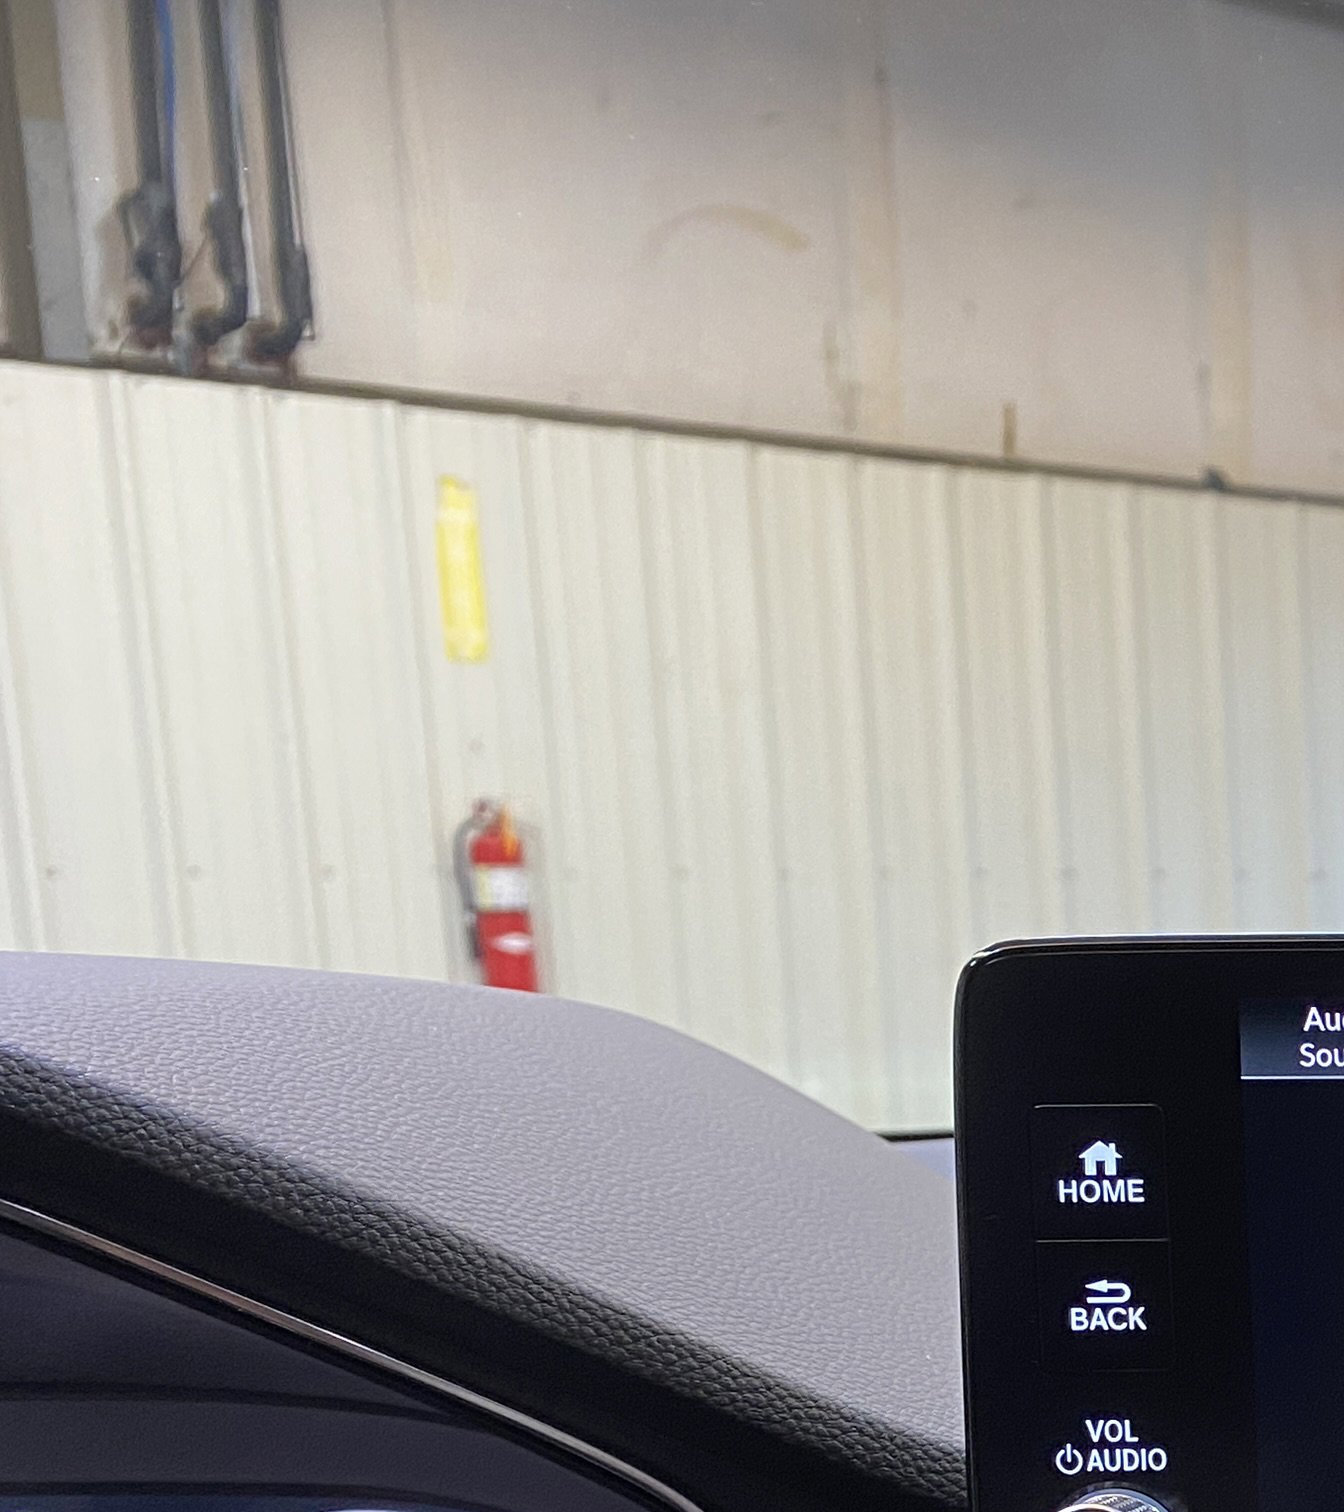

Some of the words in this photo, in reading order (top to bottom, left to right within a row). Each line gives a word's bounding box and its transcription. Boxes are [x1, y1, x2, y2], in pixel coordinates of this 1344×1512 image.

[1057, 1178, 1146, 1204] HOME
[1071, 1307, 1147, 1331] BACK
[1085, 1420, 1139, 1442] VOL
[1087, 1448, 1167, 1472] AUDIO
